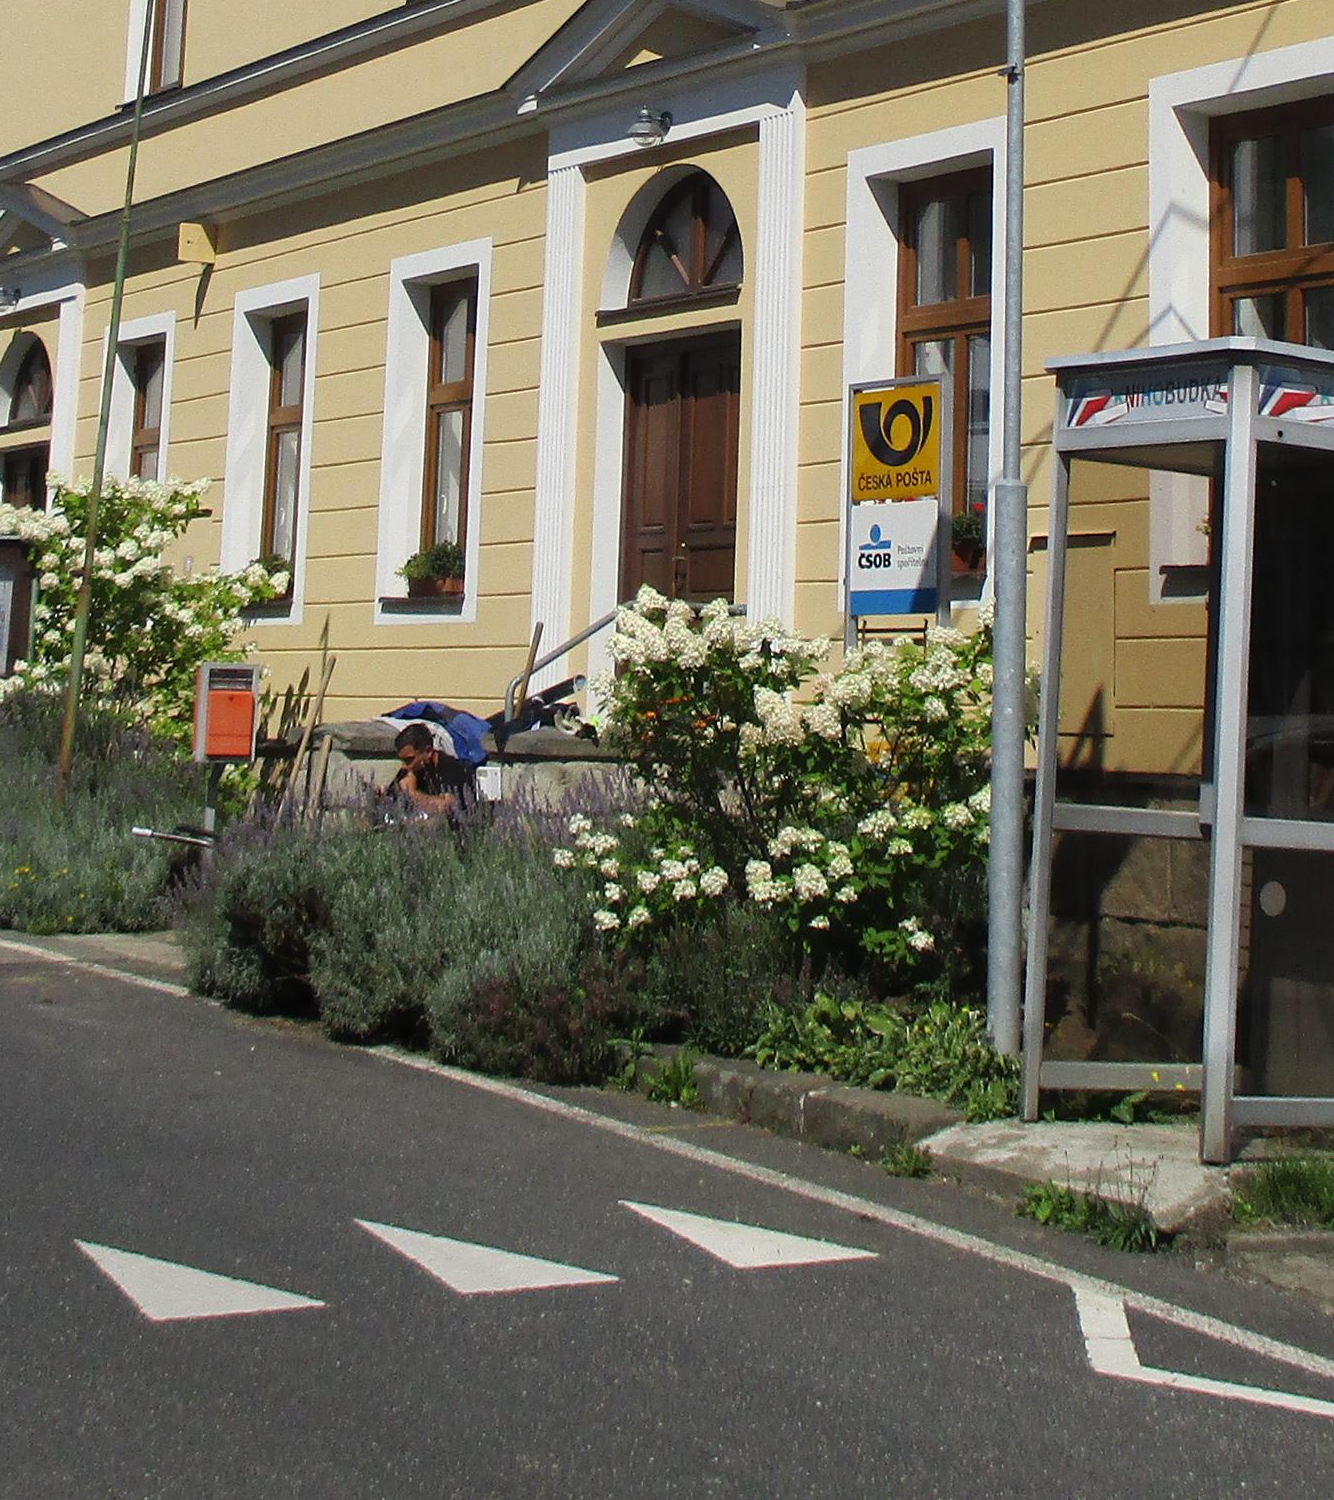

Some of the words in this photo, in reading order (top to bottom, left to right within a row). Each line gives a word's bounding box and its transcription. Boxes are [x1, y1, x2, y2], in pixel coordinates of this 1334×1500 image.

[857, 470, 893, 491] ČESKÁ
[896, 468, 932, 487] POŠTA
[858, 552, 892, 569] ČSOB
